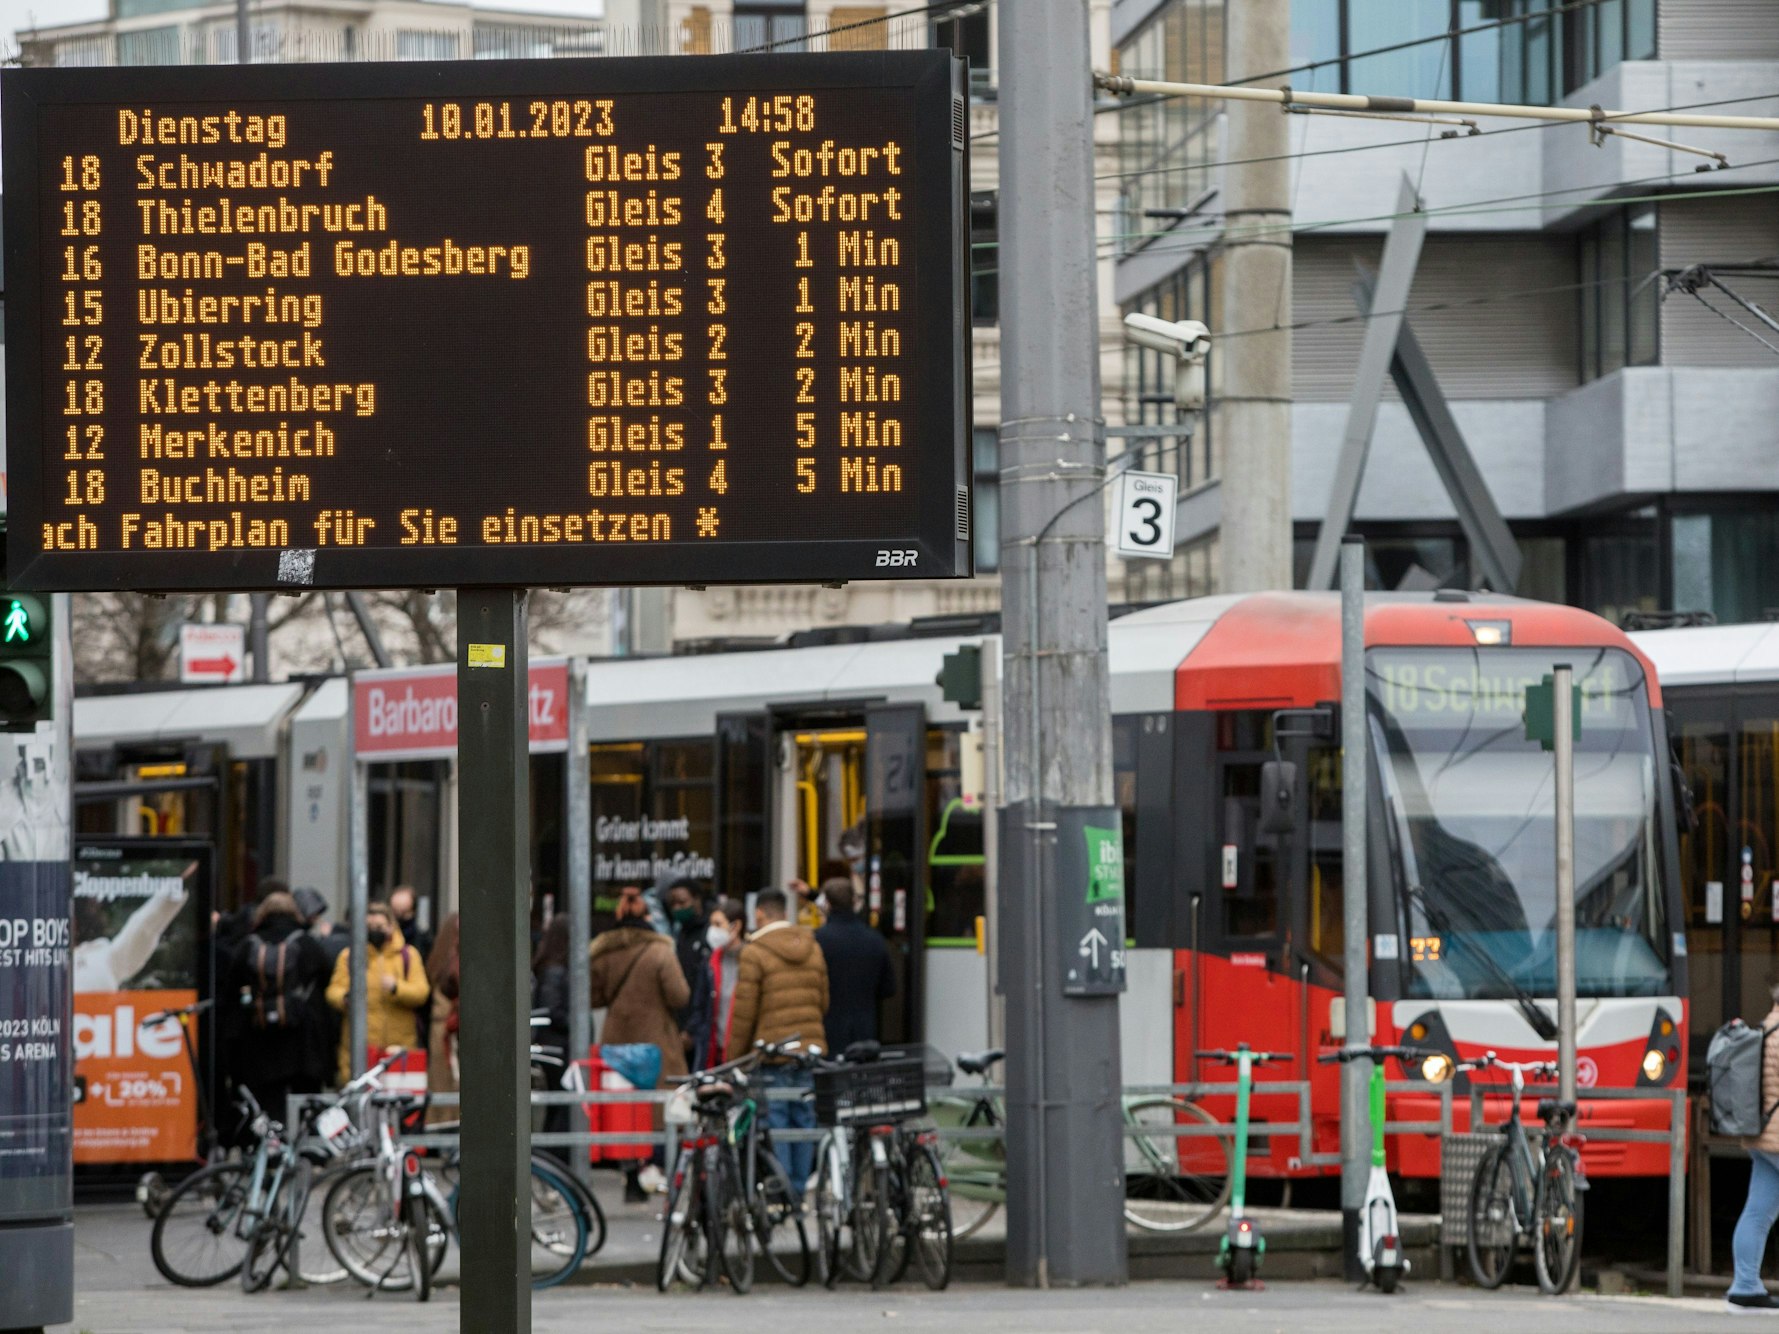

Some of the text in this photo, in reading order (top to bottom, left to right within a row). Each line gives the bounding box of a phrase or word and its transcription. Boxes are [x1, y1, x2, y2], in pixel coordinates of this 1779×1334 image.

[120, 96, 814, 148] Dienstag 10.01.2023 14:58
[61, 140, 900, 191] 18 Schwadorf Gleis 3 Sofort
[62, 186, 900, 235] 18 Thielenbruch Gleis 4 Sofort
[62, 231, 898, 280] 16 Bonn-Bad Godesberg Gleis 3 1 Min
[63, 276, 898, 327] 15 Ubierring Gleis 3 1 Min
[64, 321, 899, 370] 12 Zollstock Gleis 2 2 Min
[64, 367, 899, 416] 18 Klettenberg Gleis 3 2 Min
[65, 412, 900, 459] 12 Merkenich Gleis 1 5 Min
[65, 457, 900, 504] 18 Buchheim Gleis 4 5 Min
[1133, 480, 1164, 493] Gleis
[122, 512, 287, 551] Fahrplan
[314, 510, 375, 545] für
[401, 509, 456, 544] Sie
[483, 508, 670, 543] einsetzen
[1130, 498, 1162, 545] 3
[876, 550, 918, 566] BBR
[368, 683, 554, 736] Barbarotz
[1384, 664, 1418, 712] 18
[641, 813, 689, 840] kommt
[32, 918, 70, 948] BOYS
[24, 948, 52, 968] HITS
[31, 1015, 61, 1036] KÖLN
[14, 1042, 57, 1062] ARENA
